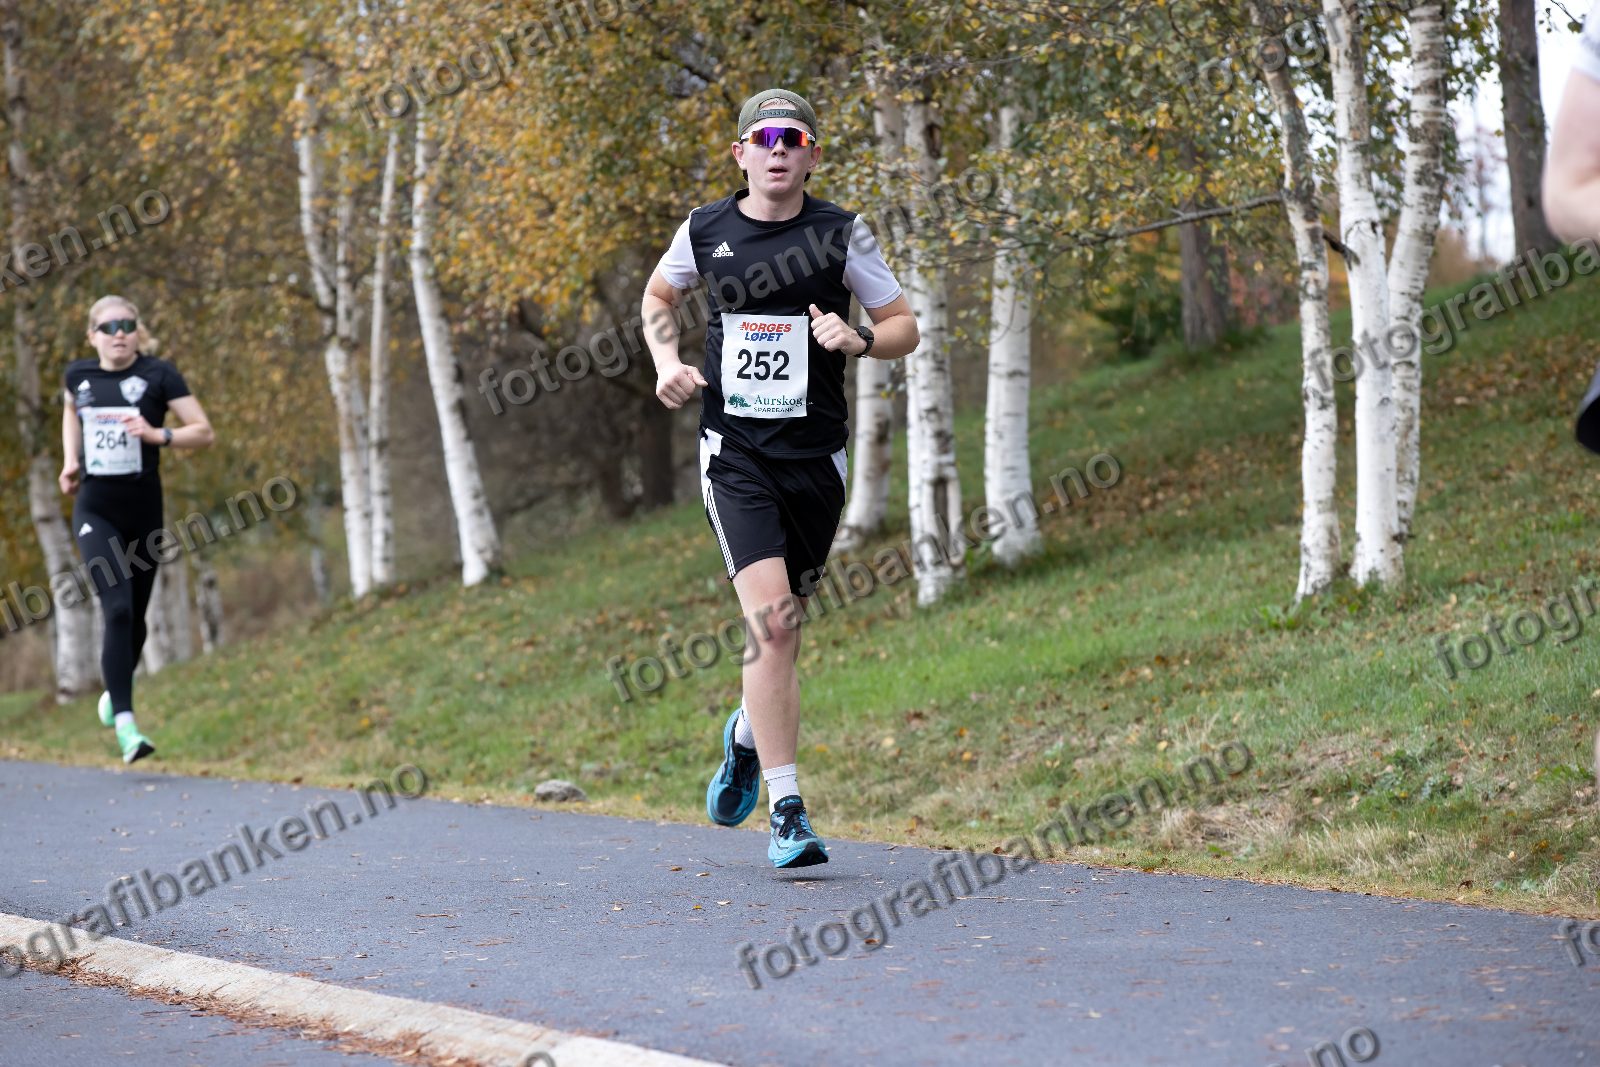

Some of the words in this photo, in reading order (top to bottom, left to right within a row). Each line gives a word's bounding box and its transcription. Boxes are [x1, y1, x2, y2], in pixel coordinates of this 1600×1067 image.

[739, 321, 792, 333] NORGES
[744, 331, 783, 342] LØPET
[736, 349, 790, 381] 252
[754, 394, 803, 408] Aurskog
[95, 430, 128, 450] 264
